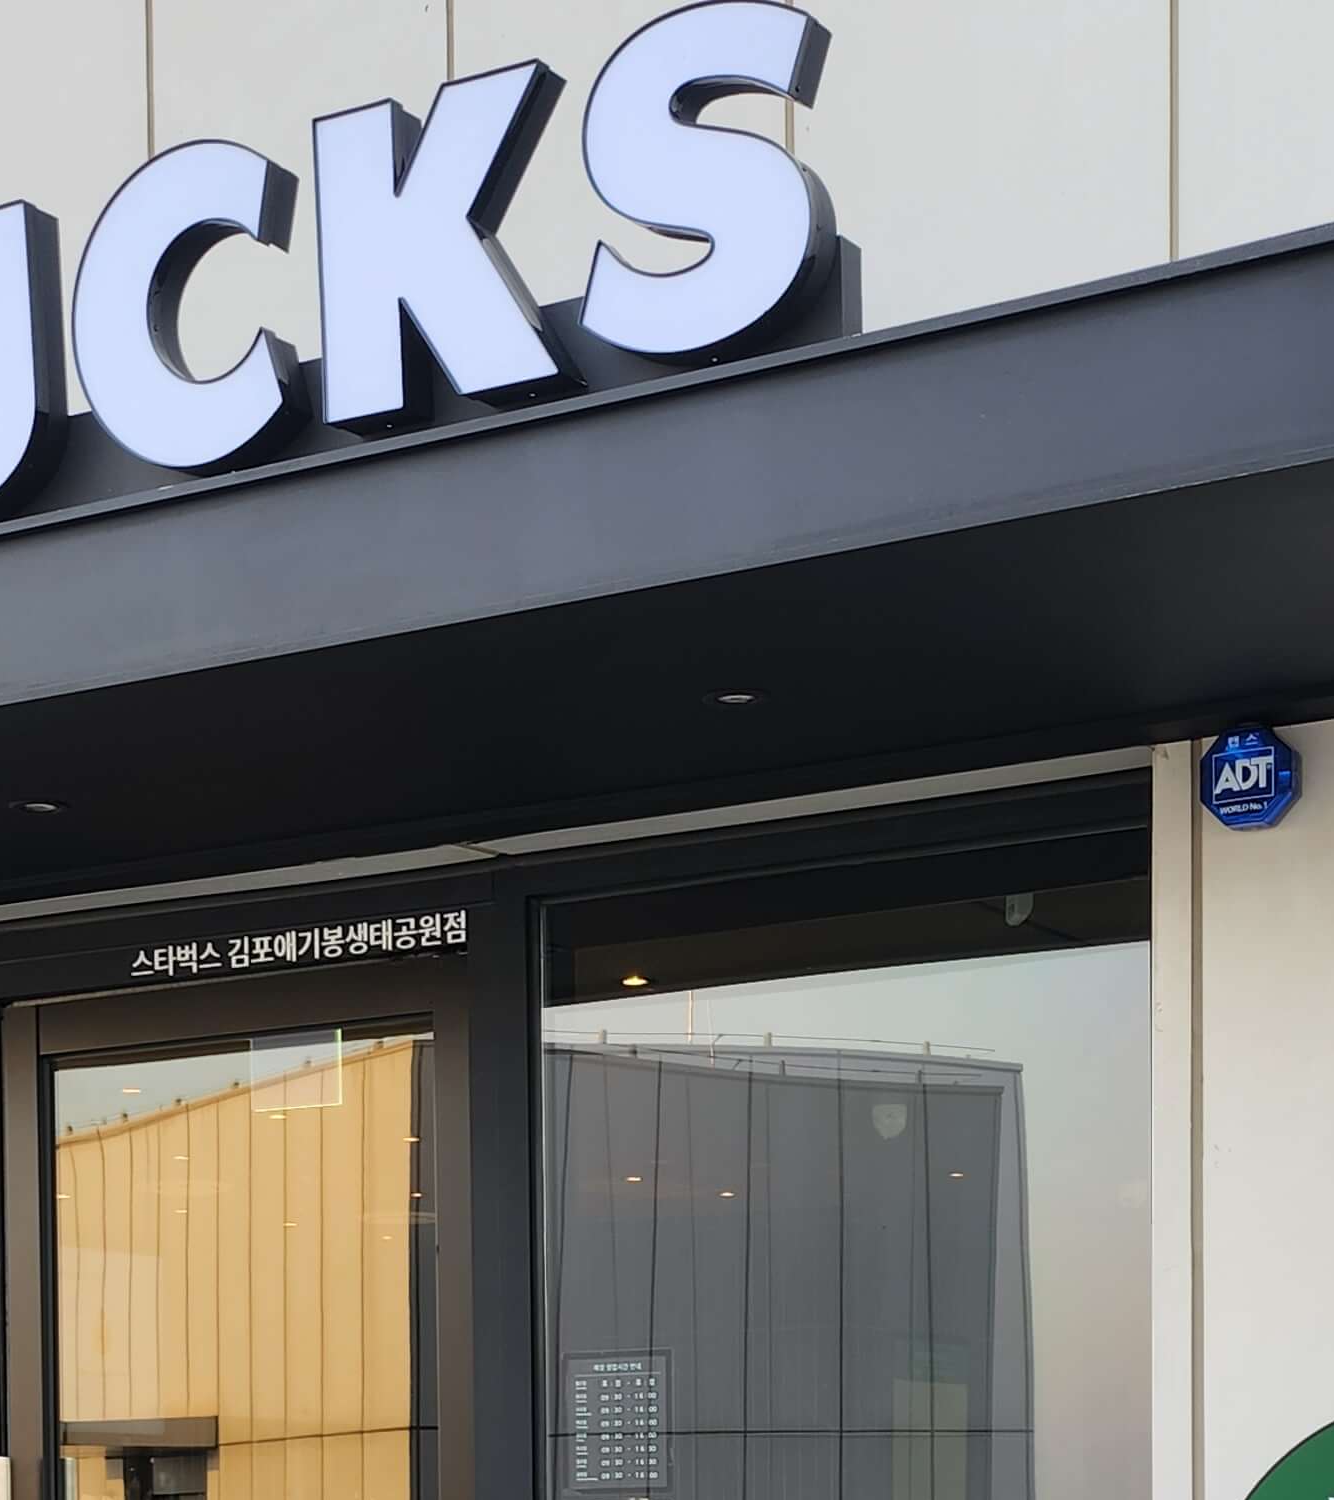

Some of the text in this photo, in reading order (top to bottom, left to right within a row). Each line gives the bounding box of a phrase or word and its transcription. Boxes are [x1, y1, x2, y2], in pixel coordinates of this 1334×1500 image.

[1214, 756, 1273, 795] ADT
[130, 910, 467, 977] 스타벅스 김포애기봉생태공원점
